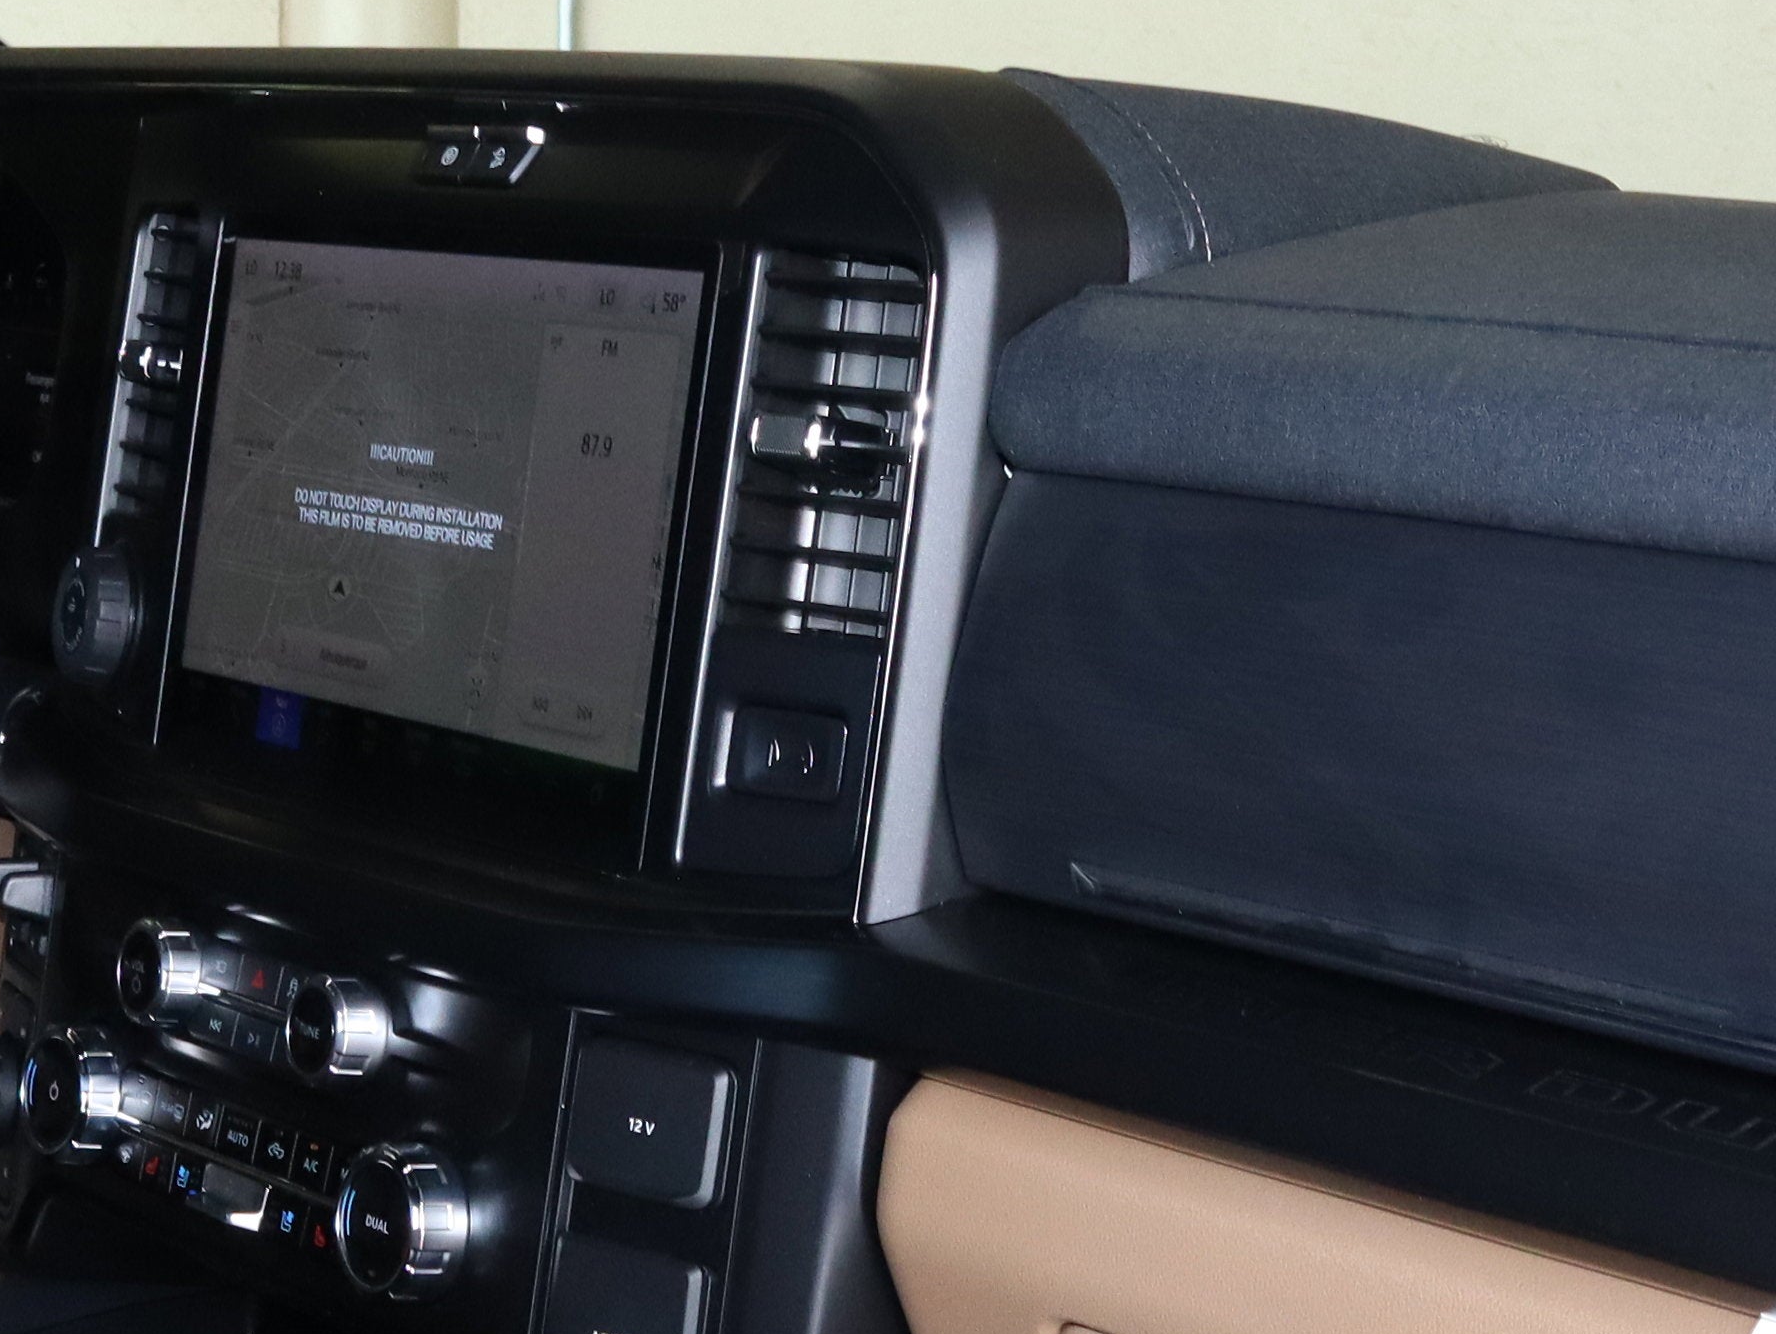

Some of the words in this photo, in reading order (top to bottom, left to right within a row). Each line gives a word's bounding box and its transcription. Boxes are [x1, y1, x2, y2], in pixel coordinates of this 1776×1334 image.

[662, 291, 687, 312] 58°
[601, 339, 618, 356] FM
[581, 432, 612, 458] 87.9
[295, 487, 308, 503] DO
[309, 490, 328, 506] NOT
[329, 492, 361, 512] TOUCH
[361, 496, 399, 516] DISPLAY
[399, 503, 435, 521] DURING
[436, 507, 503, 531] INSTALLATION
[298, 507, 319, 524] THIS
[319, 510, 340, 527] FILM
[341, 513, 350, 528] IS
[351, 514, 363, 531] TO
[364, 517, 377, 532] BE
[377, 519, 423, 539] REMOVED
[423, 525, 461, 544] BEFORE
[461, 531, 494, 550] USAGE
[628, 1117, 642, 1133] 12
[646, 1121, 655, 1136] V
[227, 1130, 249, 1147] AUTO
[303, 1157, 319, 1173] A/C
[365, 1213, 389, 1235] DUAL
